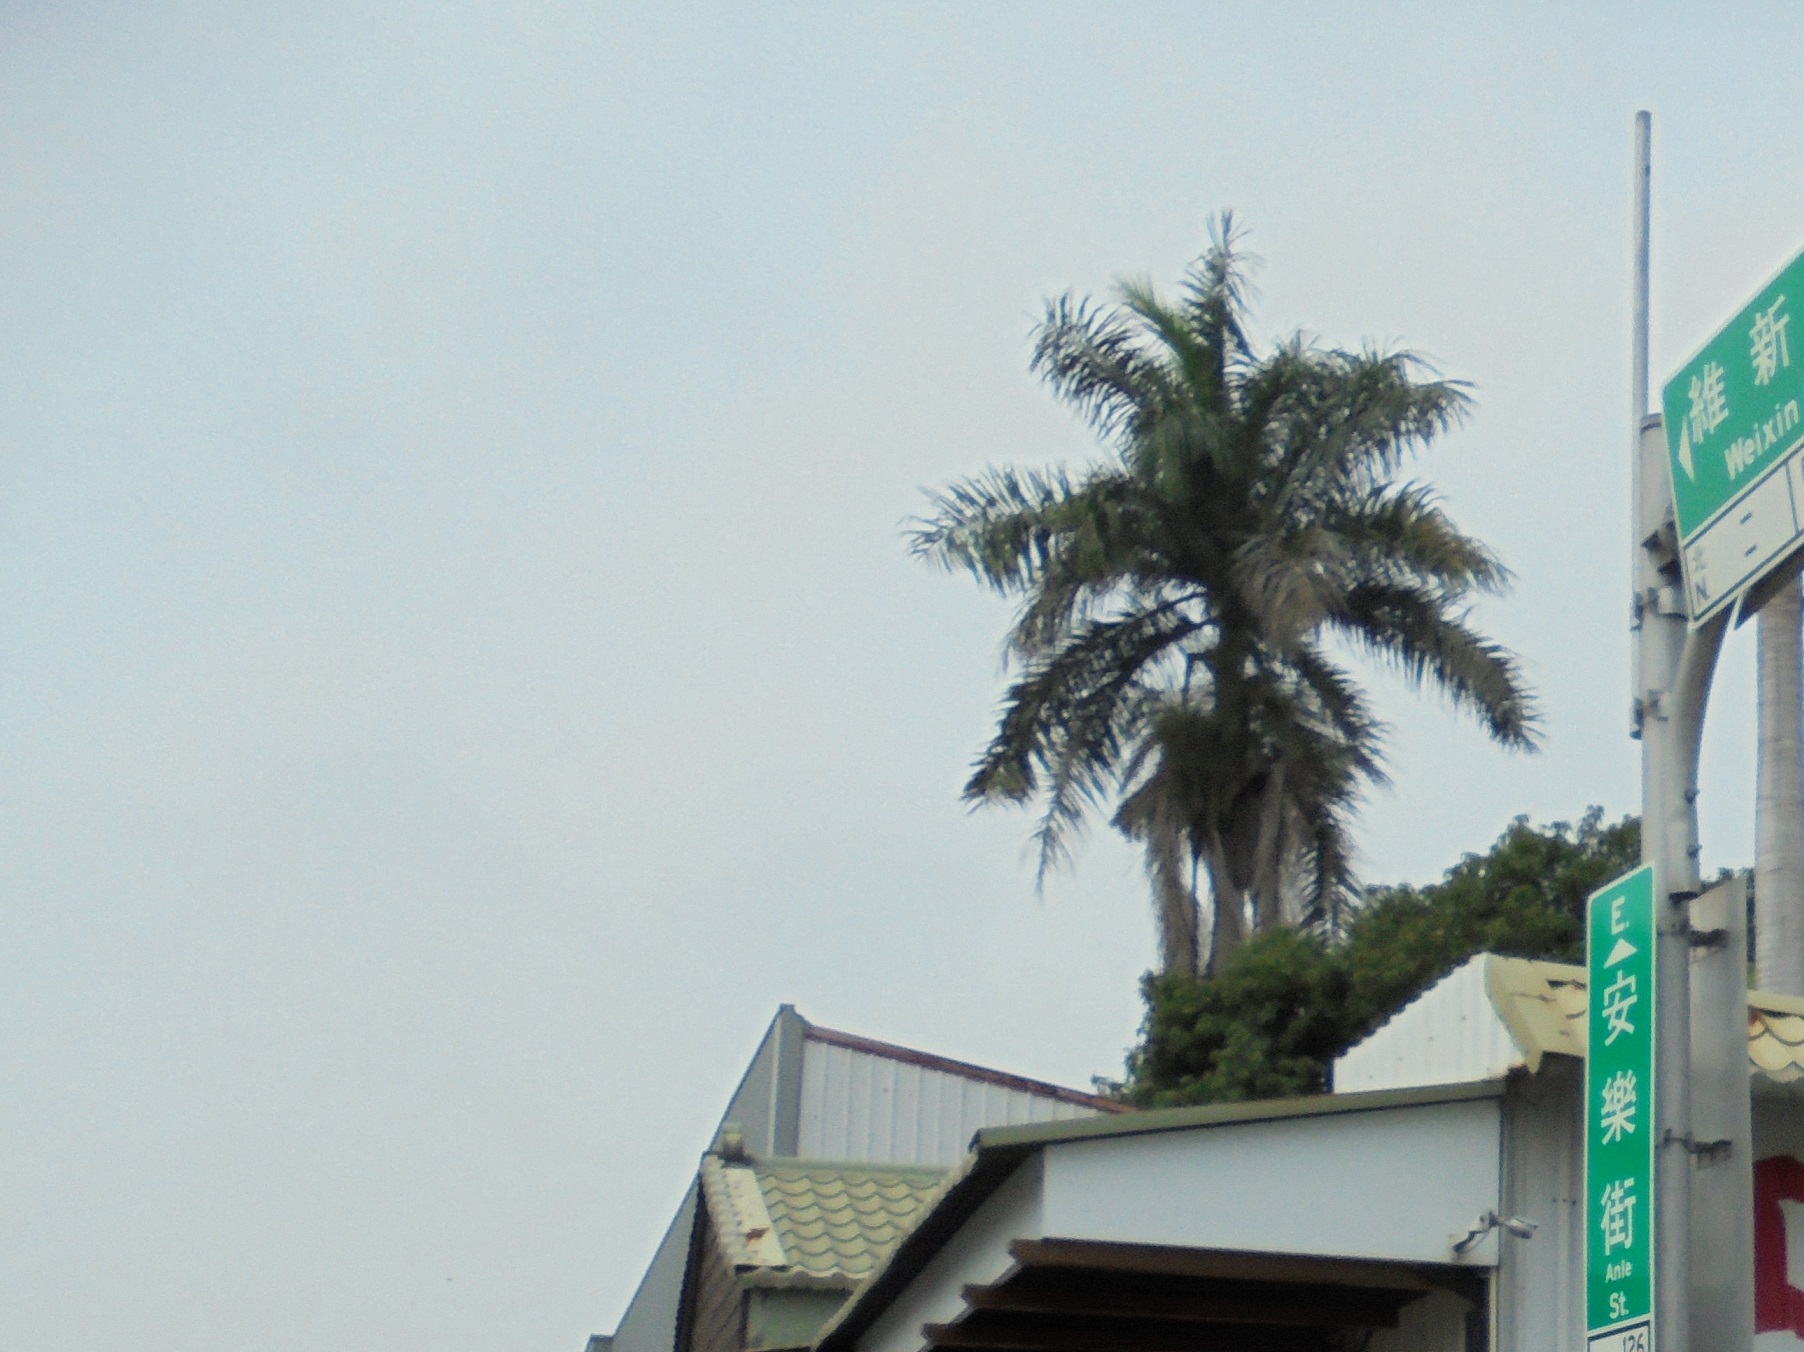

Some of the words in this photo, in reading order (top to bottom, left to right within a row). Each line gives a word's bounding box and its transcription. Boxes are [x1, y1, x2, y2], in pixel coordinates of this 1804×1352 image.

[1723, 398, 1801, 481] Weixin
[1600, 968, 1639, 1257] 安樂街
[1605, 1260, 1633, 1283] Anle
[1608, 1291, 1630, 1318] St.
